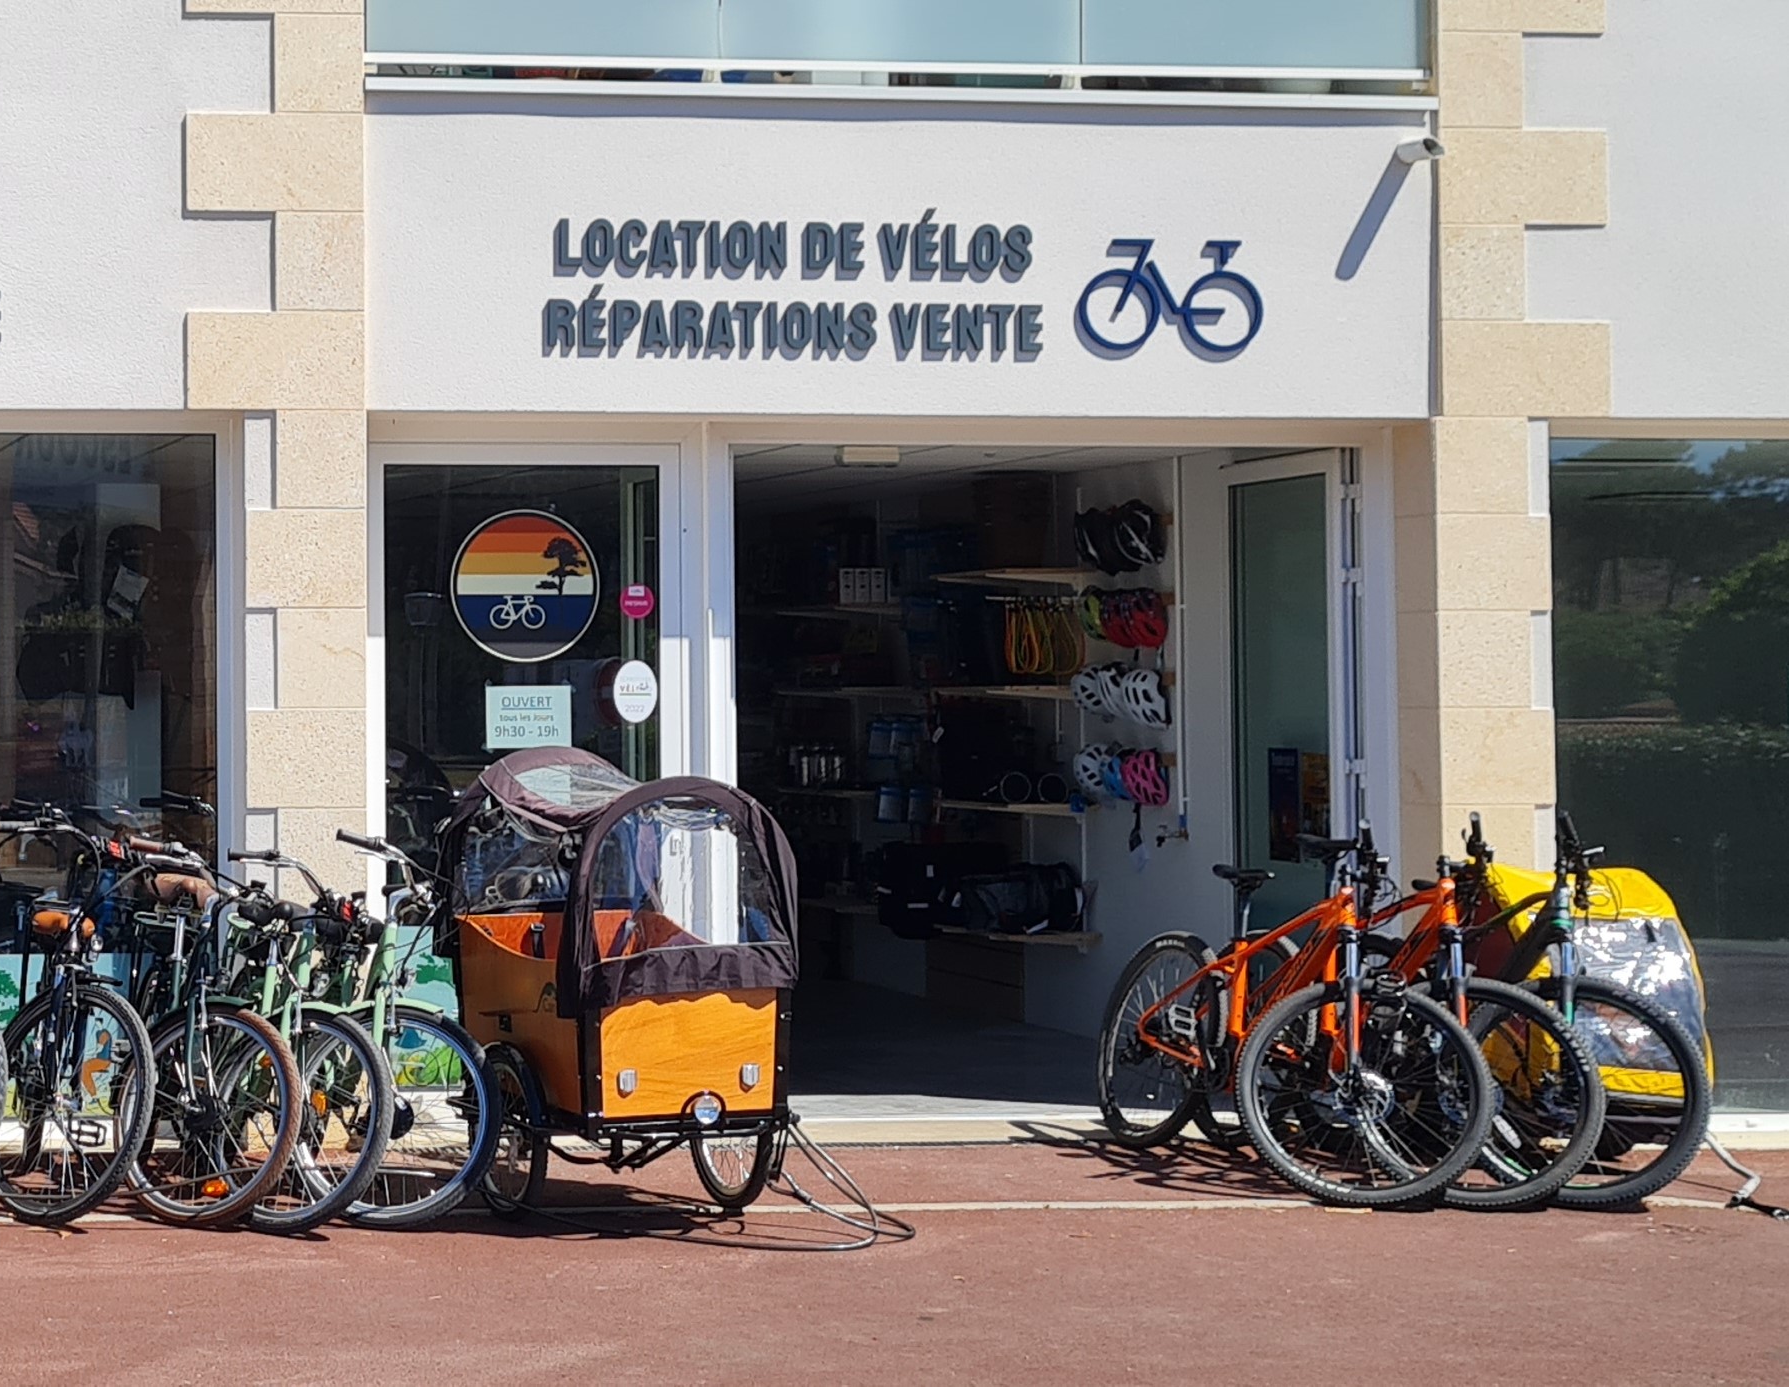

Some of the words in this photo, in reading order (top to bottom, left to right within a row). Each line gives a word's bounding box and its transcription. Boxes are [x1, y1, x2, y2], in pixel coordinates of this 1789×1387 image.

[553, 218, 787, 280] LOCATION
[801, 222, 865, 281] DE
[876, 207, 1033, 284] VÉLOS
[542, 283, 877, 362] RÉPARATIONS
[888, 302, 1044, 363] VENTE
[501, 696, 552, 708] OUVERT
[499, 714, 518, 722] tous
[519, 712, 531, 722] les
[494, 725, 526, 737] 9h30
[537, 725, 559, 737] 19h
